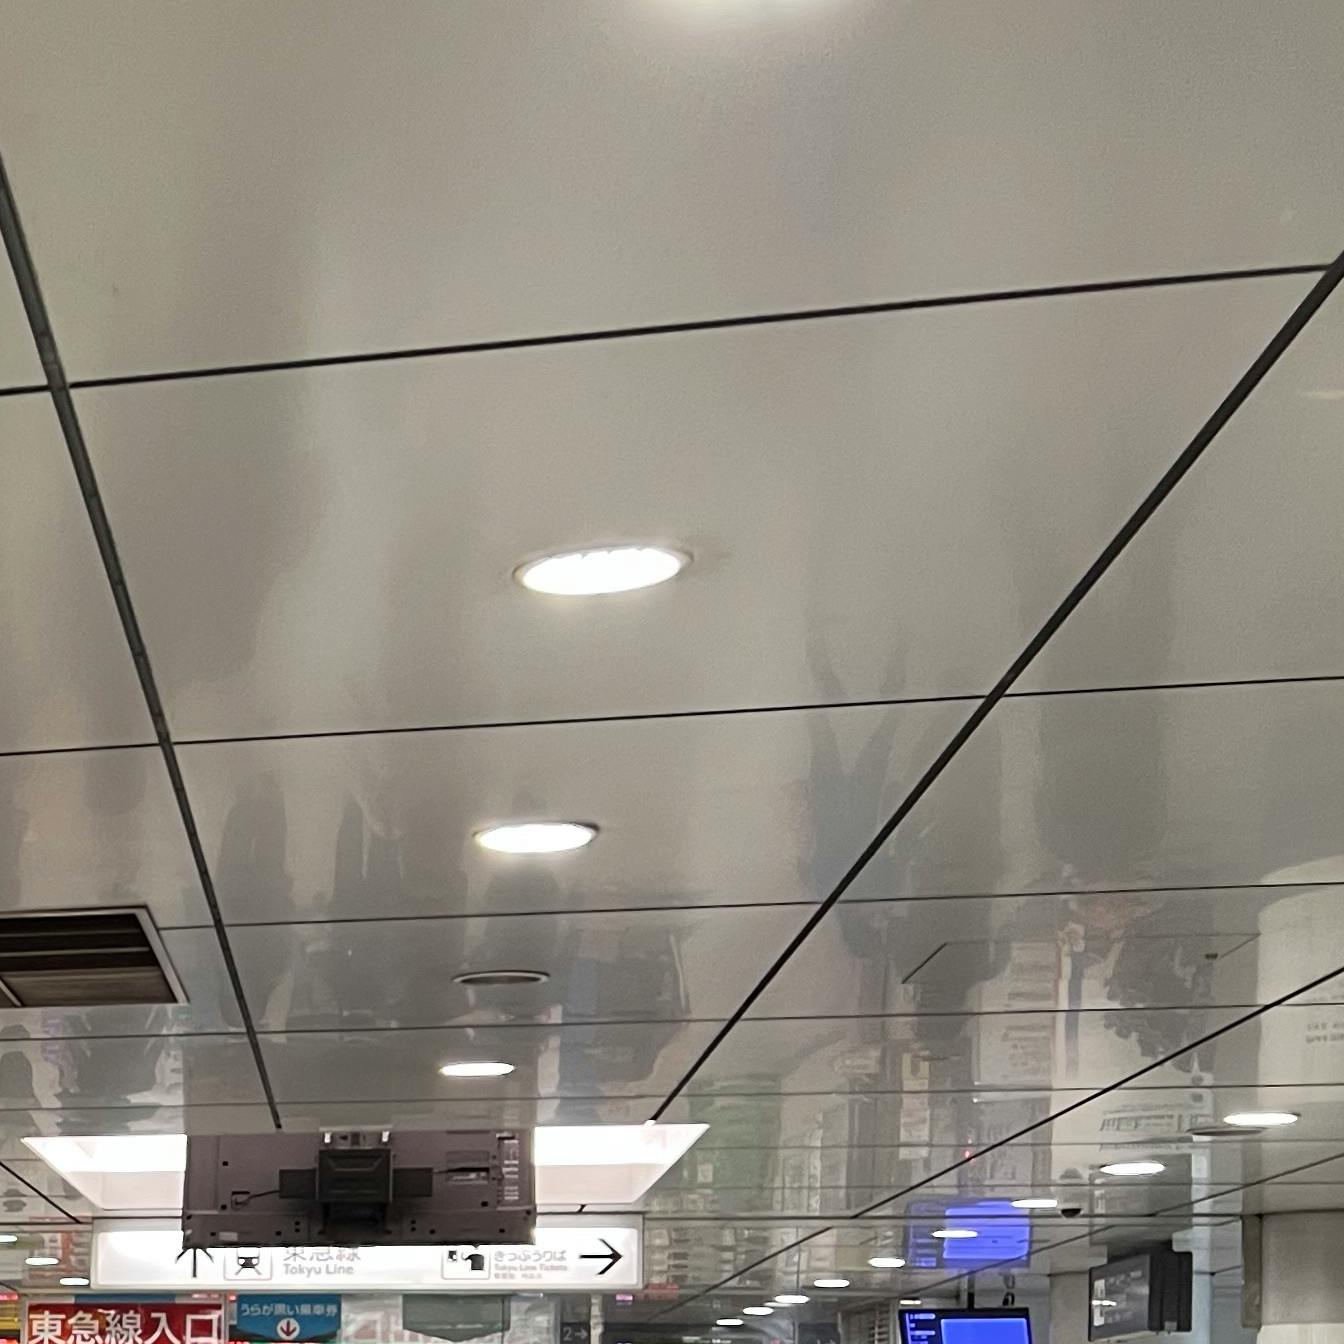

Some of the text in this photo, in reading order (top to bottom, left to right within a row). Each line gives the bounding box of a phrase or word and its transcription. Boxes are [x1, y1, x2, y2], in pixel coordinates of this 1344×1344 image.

[494, 1249, 567, 1262] きっぷうりば
[283, 1263, 354, 1278] Tokyu Line
